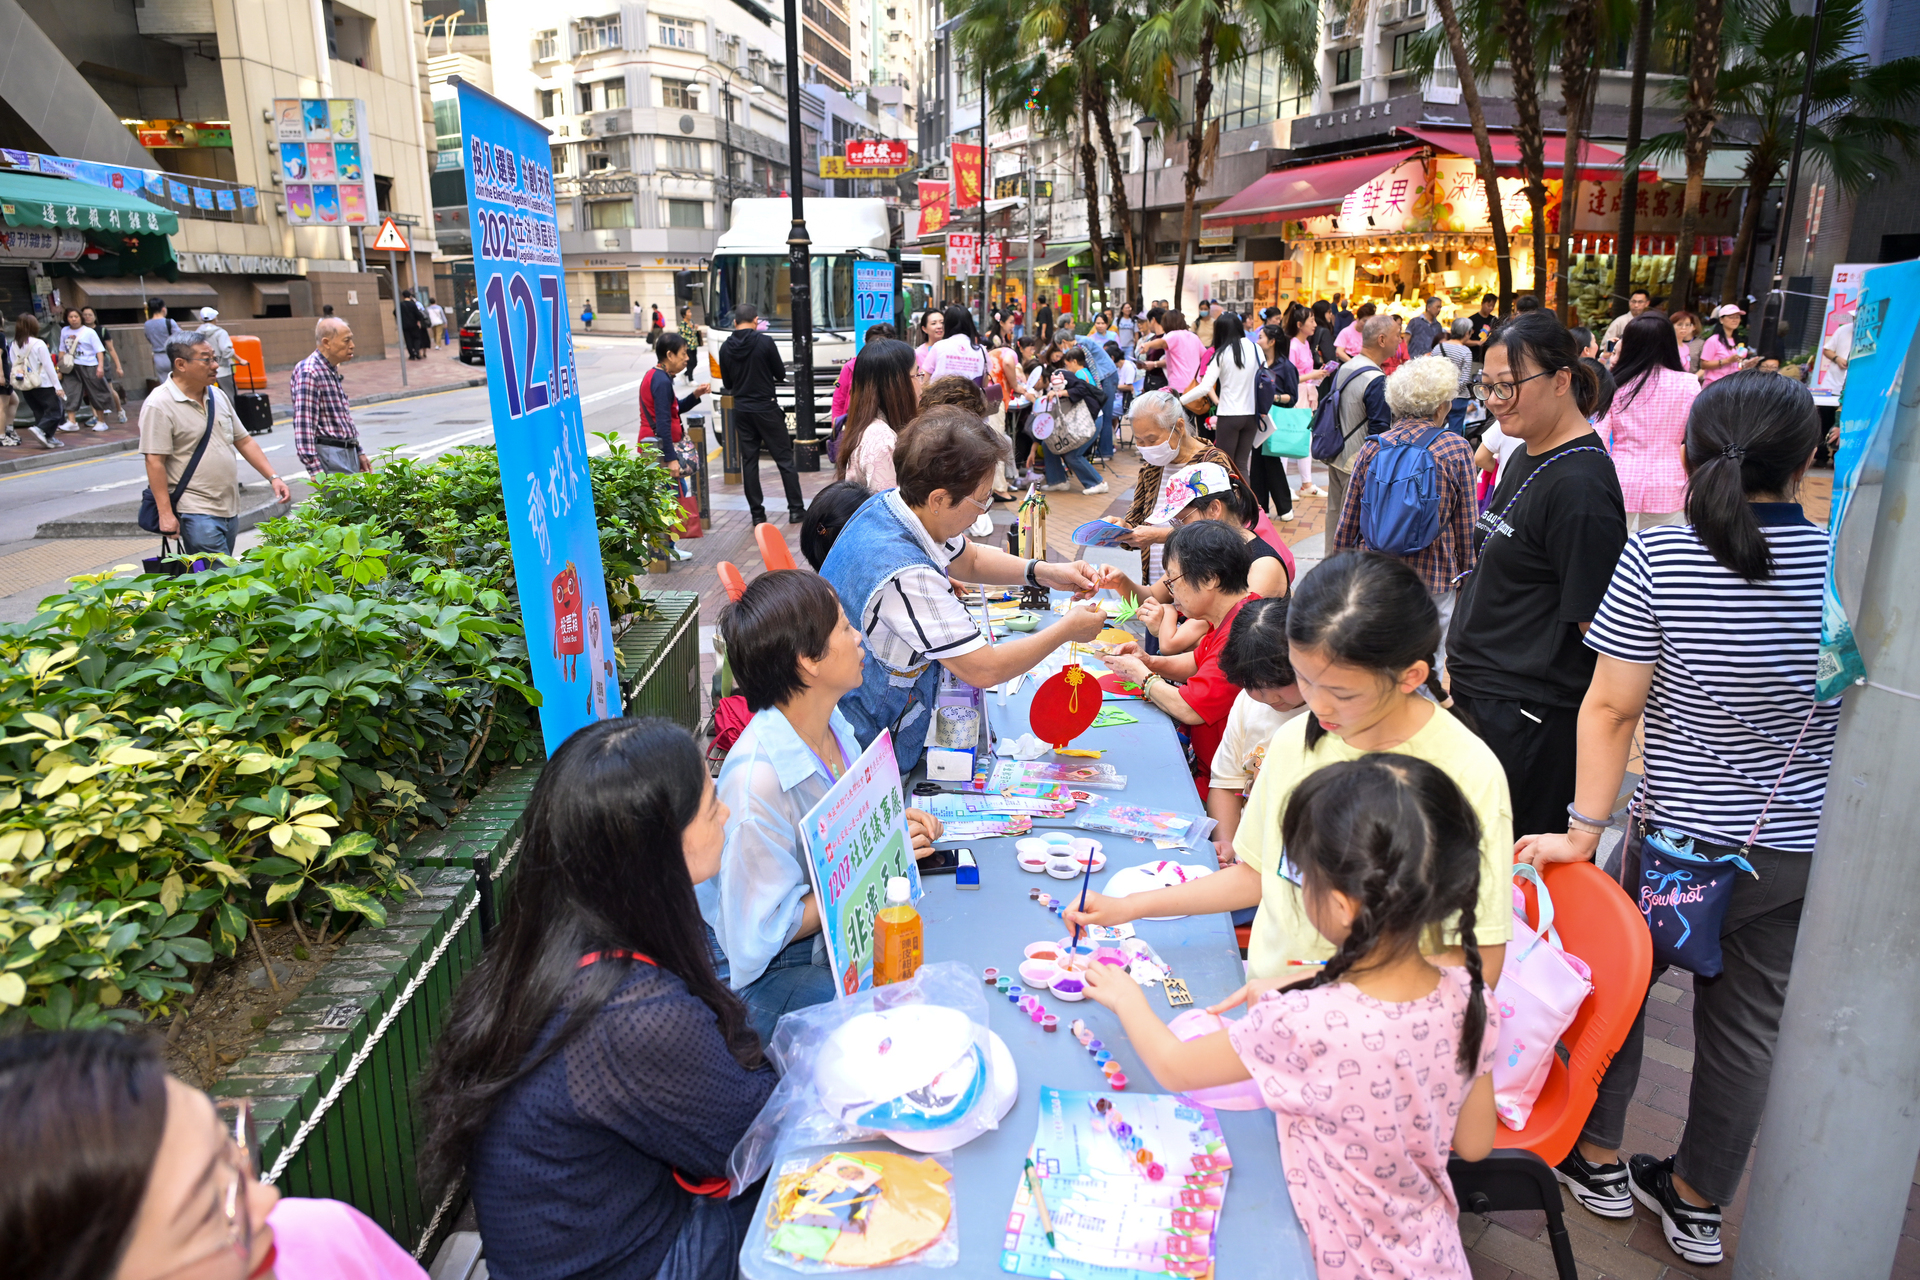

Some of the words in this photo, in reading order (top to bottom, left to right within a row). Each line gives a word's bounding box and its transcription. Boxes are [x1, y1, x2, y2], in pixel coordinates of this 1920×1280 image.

[471, 136, 517, 187] 投入選舉
[521, 156, 552, 200] 共創未來
[195, 254, 232, 273] WAN
[560, 612, 579, 635] 投票箱
[1639, 884, 1707, 915] Bowknot
